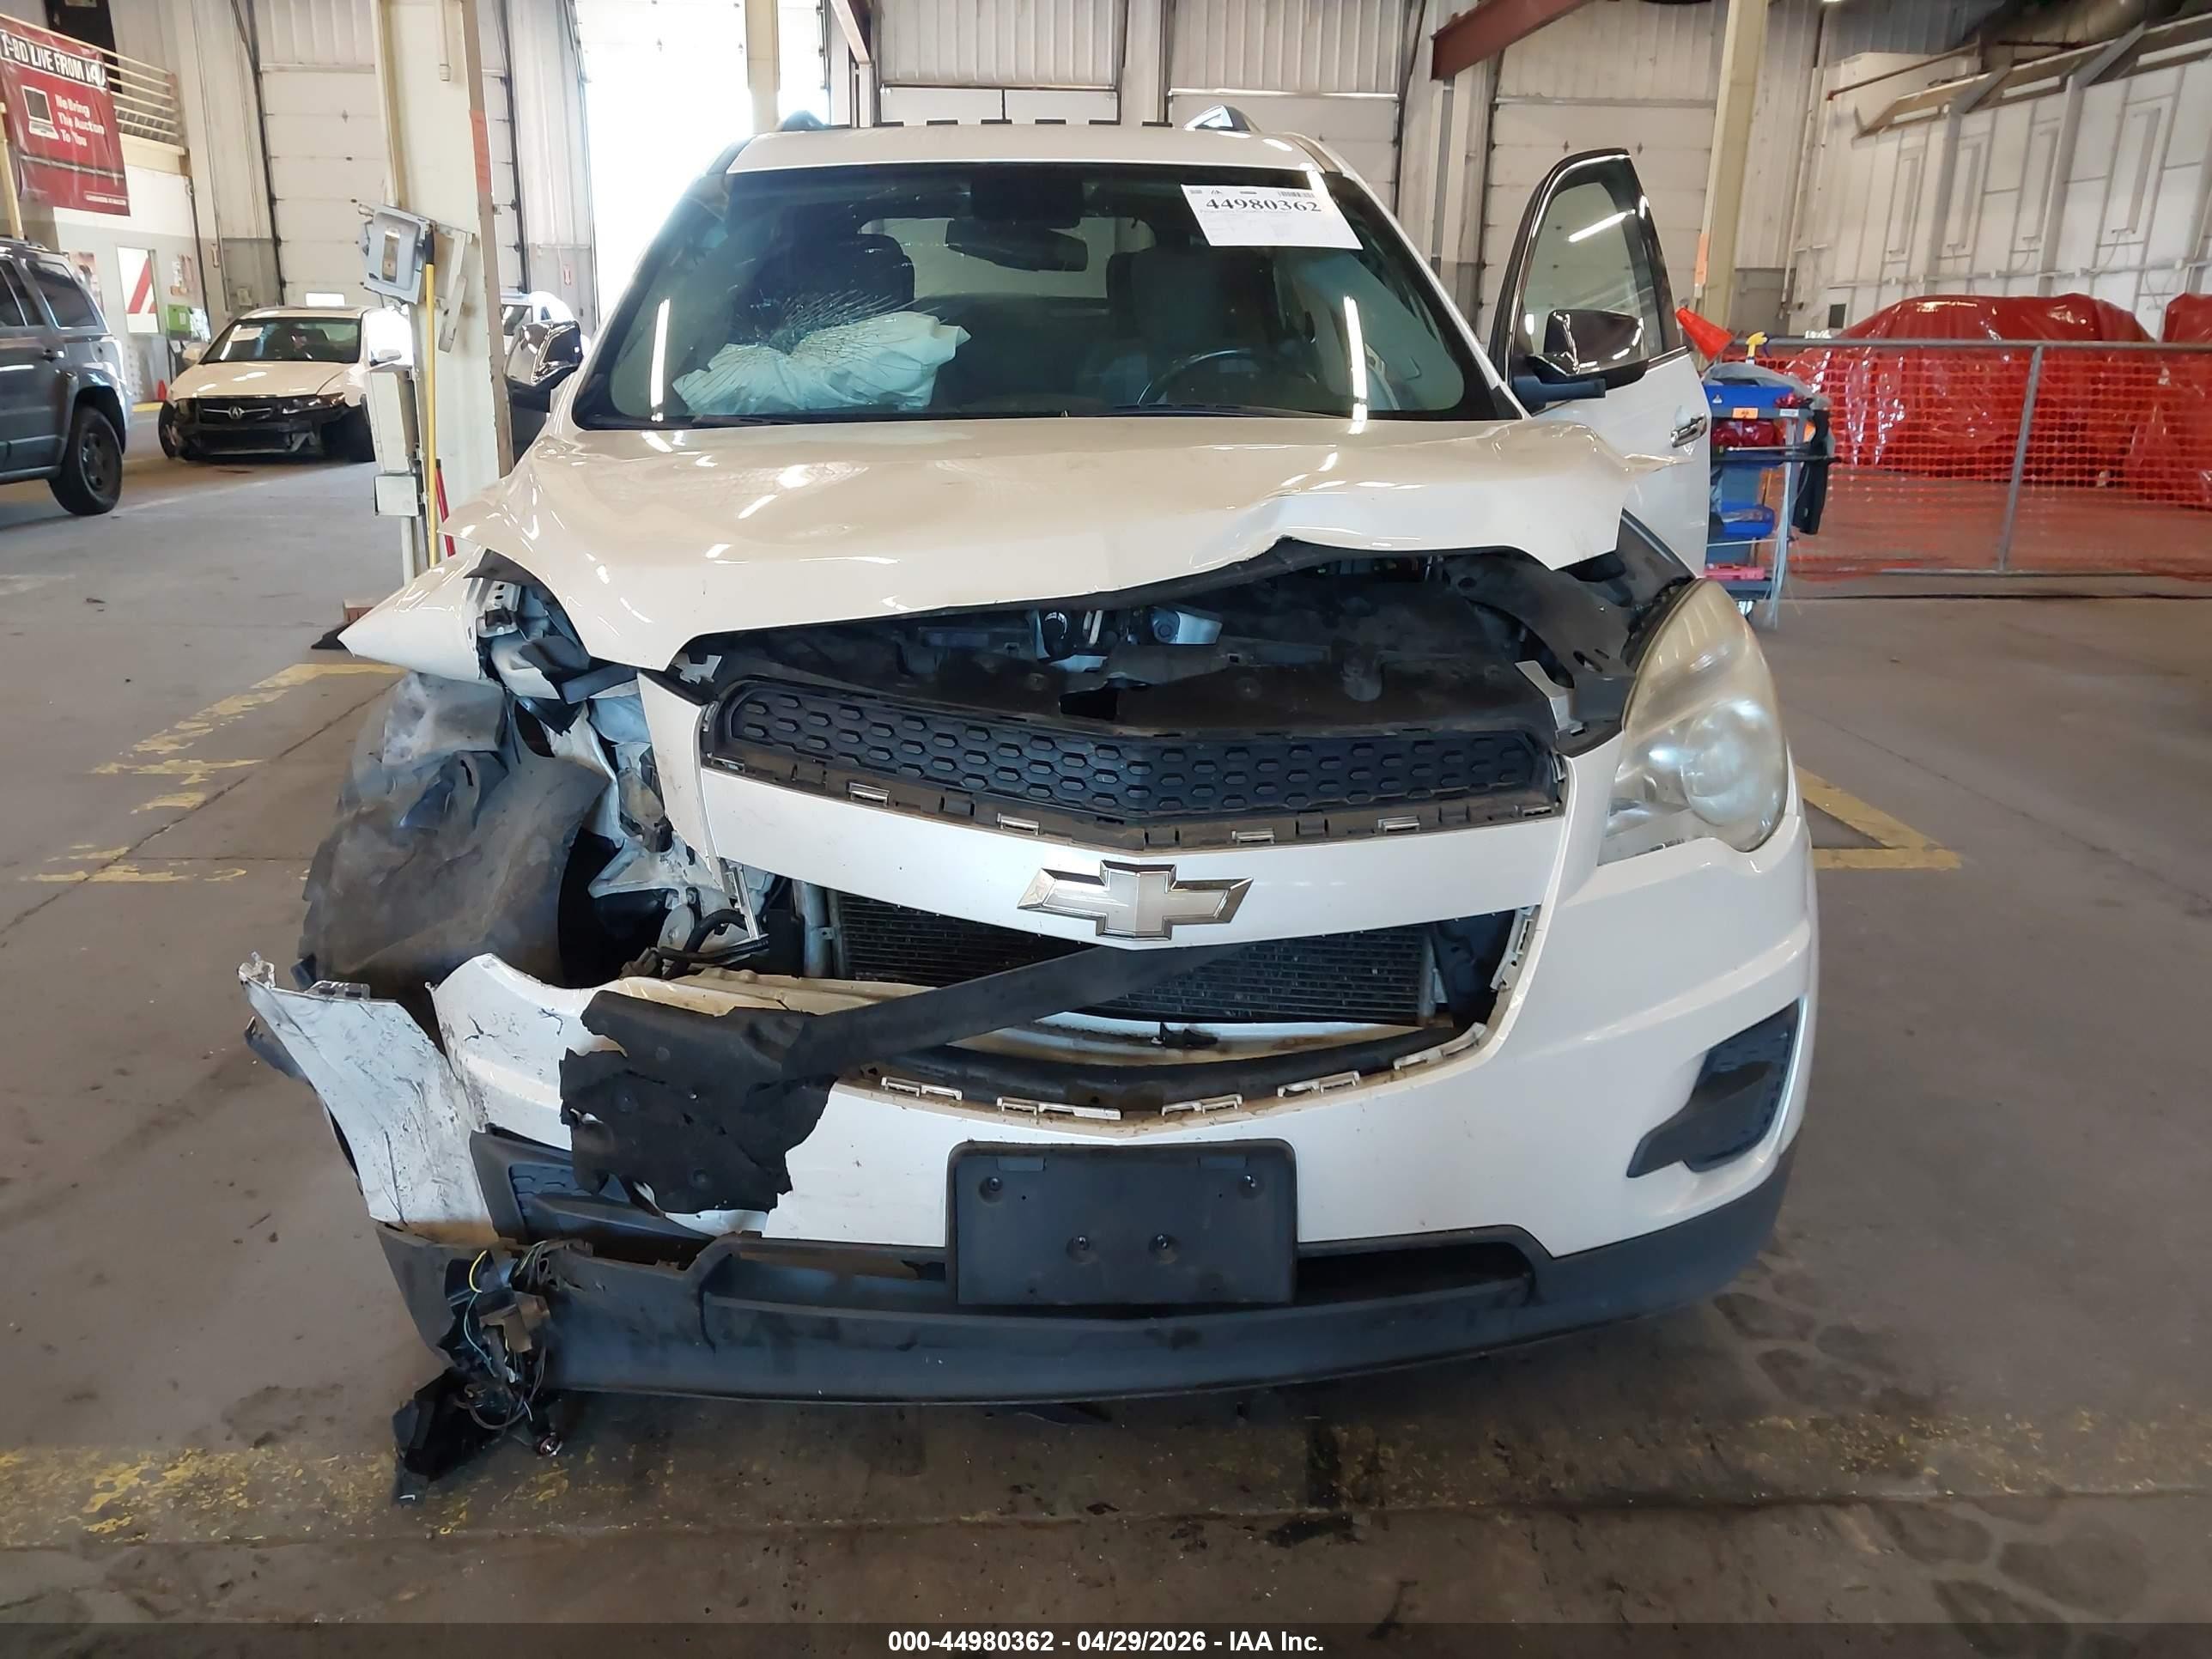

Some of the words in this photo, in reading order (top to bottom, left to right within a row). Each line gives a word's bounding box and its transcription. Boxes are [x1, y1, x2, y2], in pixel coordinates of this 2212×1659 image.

[27, 43, 54, 71] LIVE
[53, 52, 84, 81] FROM
[68, 98, 90, 118] Bring
[58, 112, 73, 128] The
[59, 129, 71, 143] To
[1206, 198, 1322, 212] 44980362
